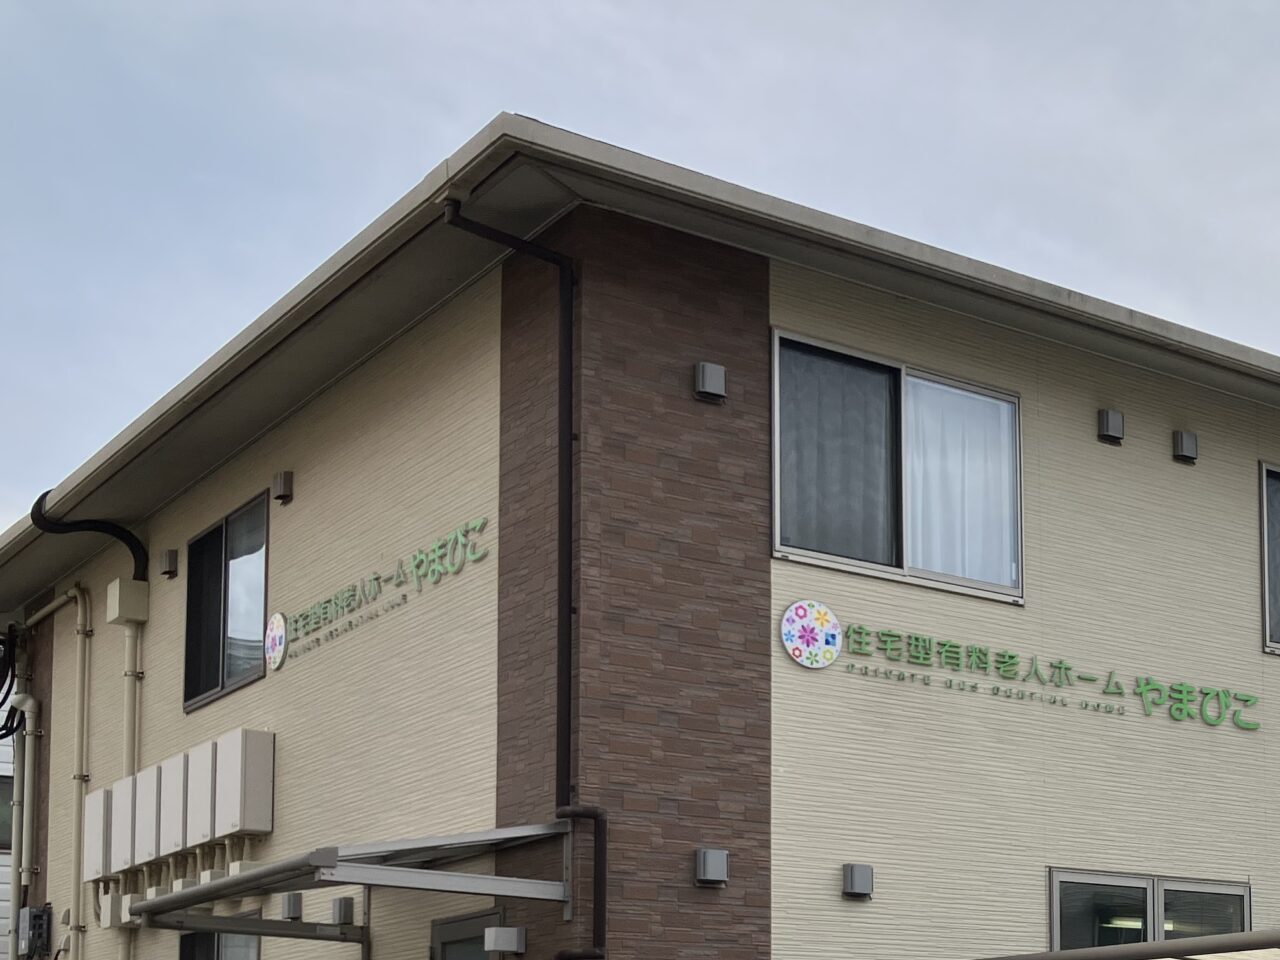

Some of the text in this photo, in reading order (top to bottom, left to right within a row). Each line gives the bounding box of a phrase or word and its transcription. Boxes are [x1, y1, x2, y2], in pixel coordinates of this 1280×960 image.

[411, 517, 489, 592] やまびこ
[846, 624, 1261, 730] 住宅型有料老人ホーム やまびこ
